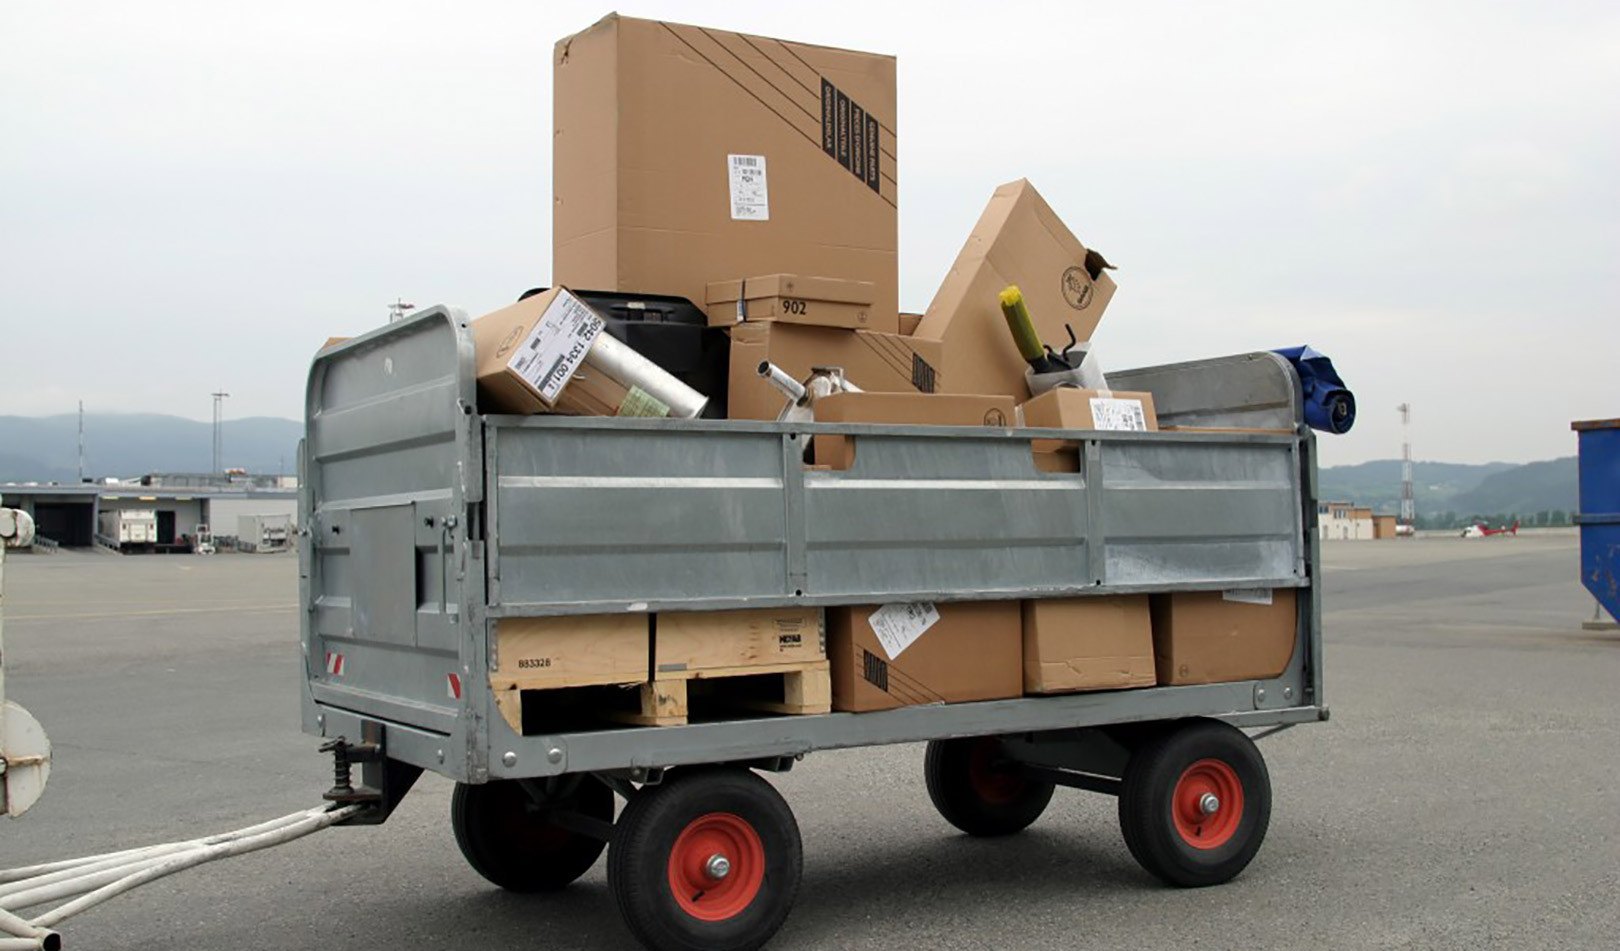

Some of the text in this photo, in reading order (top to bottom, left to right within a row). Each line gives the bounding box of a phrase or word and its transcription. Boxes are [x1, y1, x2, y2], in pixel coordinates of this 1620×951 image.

[783, 300, 806, 315] 902
[583, 317, 602, 341] 5042
[565, 341, 585, 364] 1334
[554, 363, 569, 382] 001
